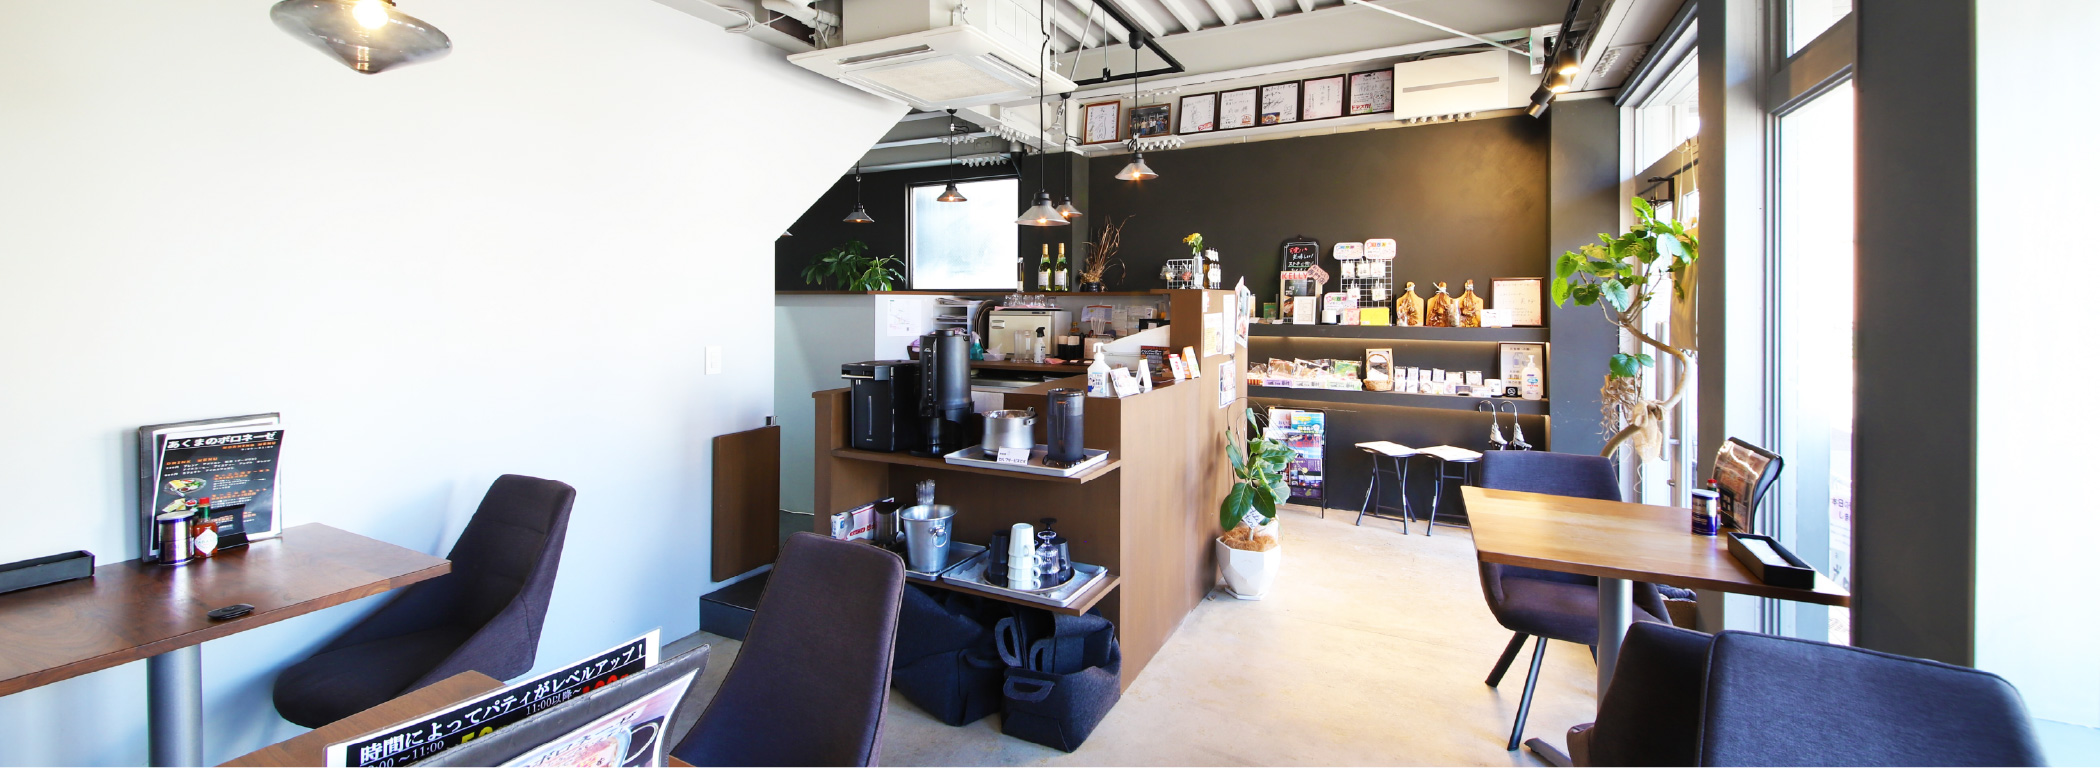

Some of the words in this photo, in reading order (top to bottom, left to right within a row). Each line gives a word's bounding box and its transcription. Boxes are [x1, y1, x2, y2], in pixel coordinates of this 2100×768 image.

[167, 431, 277, 449] あくまのボロネーゼ
[360, 643, 643, 764] 時間によってパティがレベルアップ！
